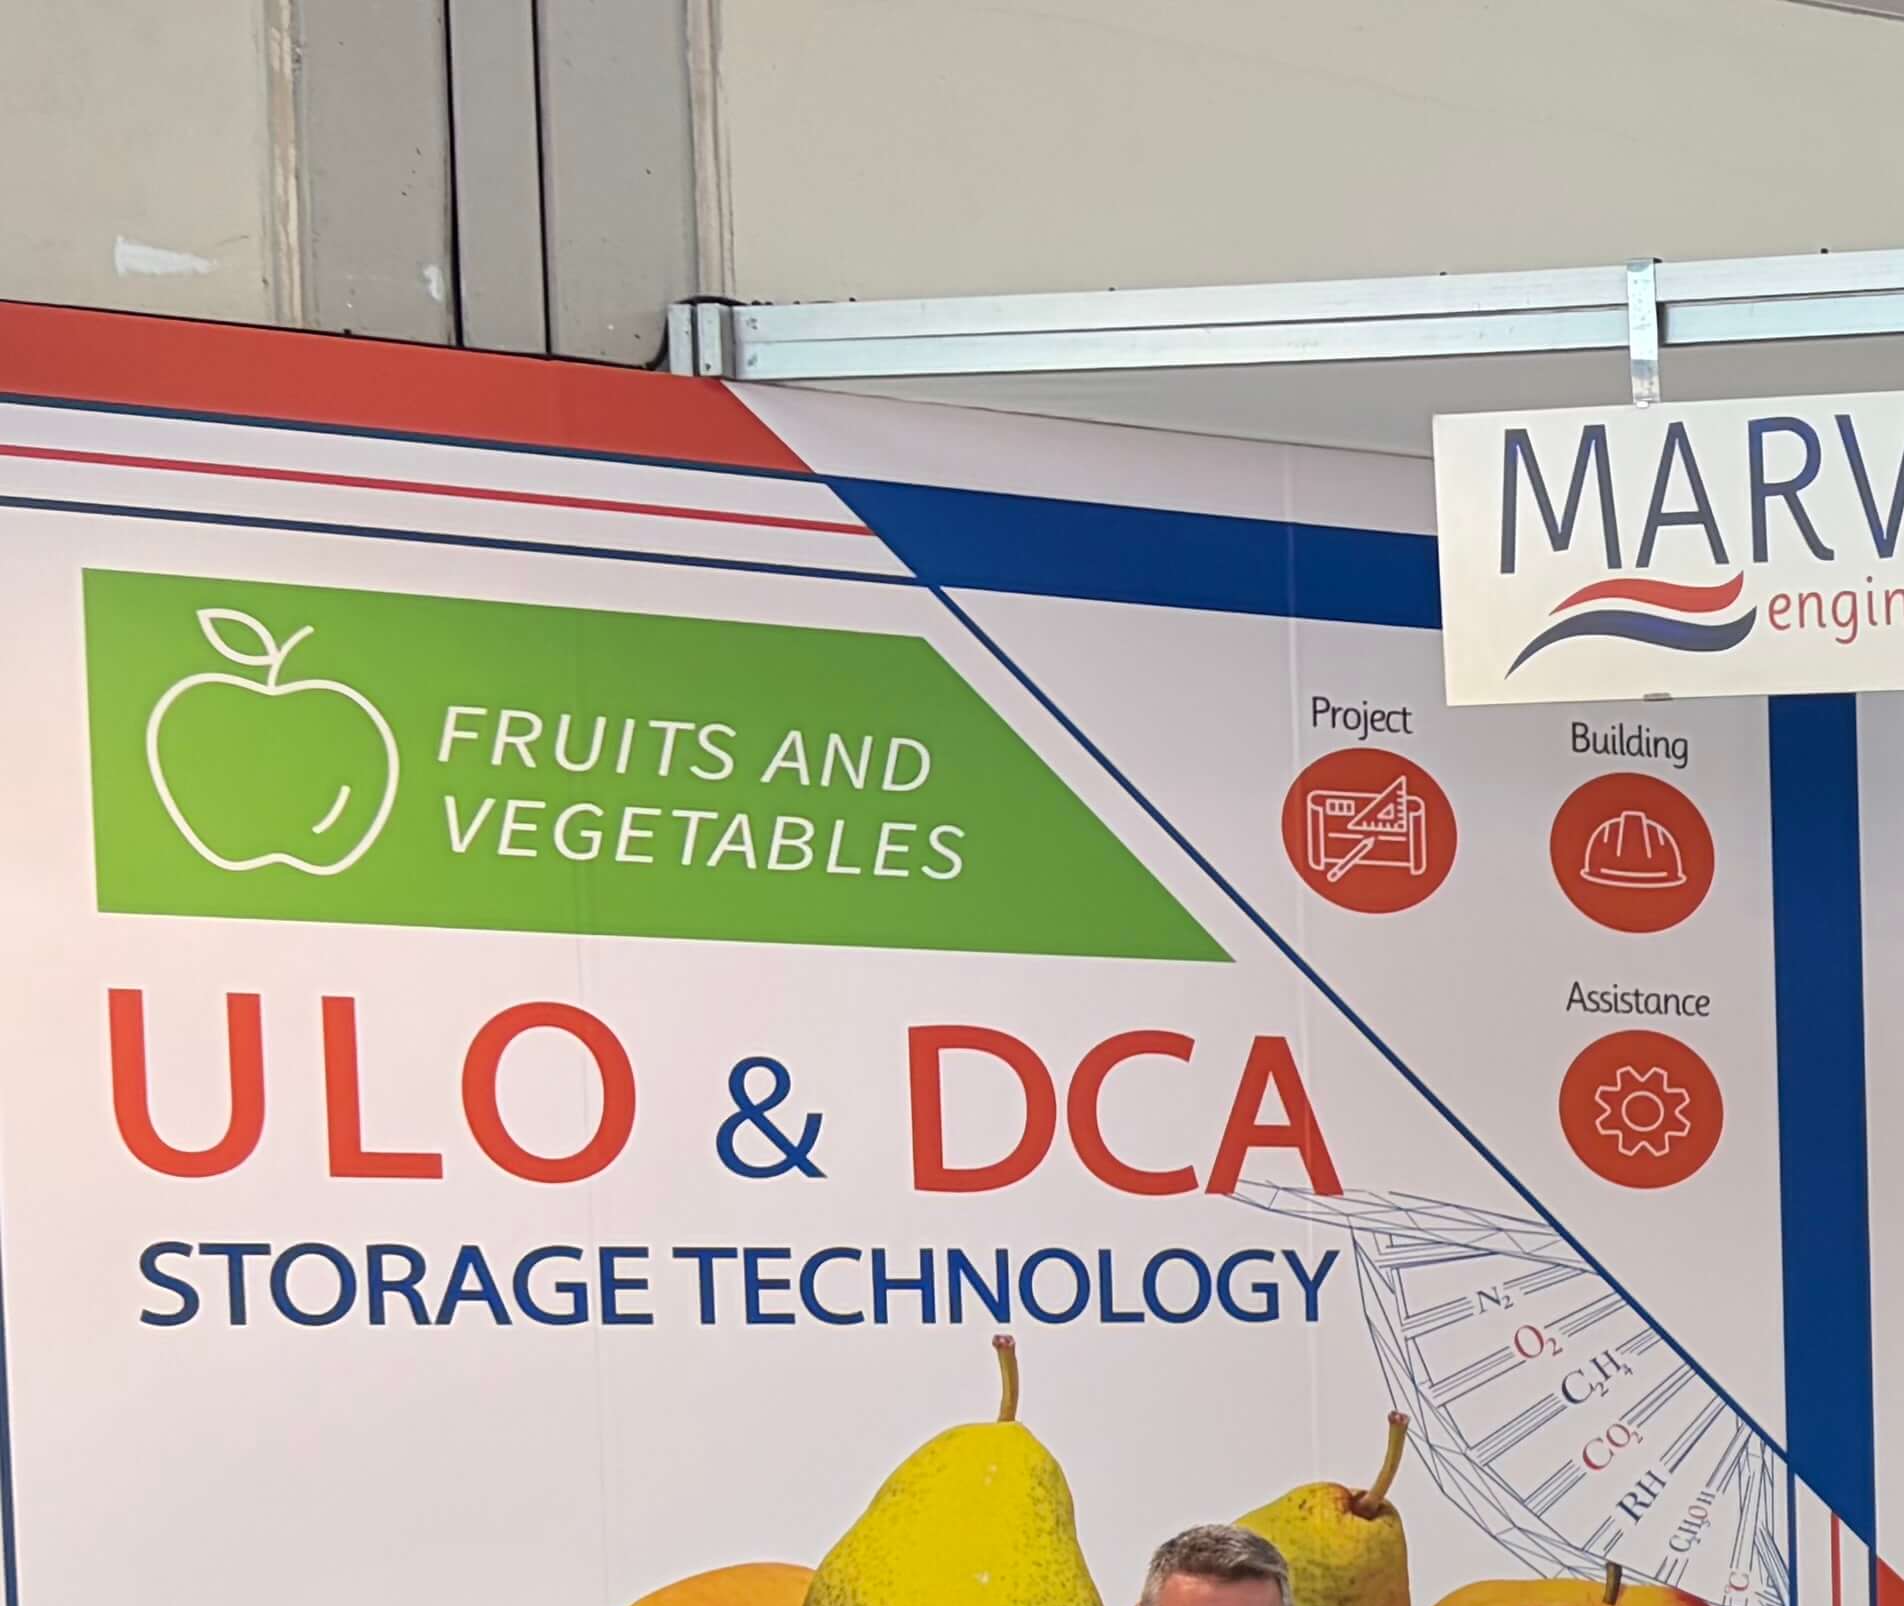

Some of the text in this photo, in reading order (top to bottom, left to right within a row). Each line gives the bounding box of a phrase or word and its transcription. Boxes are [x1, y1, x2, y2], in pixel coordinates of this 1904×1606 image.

[436, 705, 933, 794] FRUITS AND
[1309, 697, 1412, 739] Project
[1570, 722, 1690, 769] Building
[442, 795, 966, 881] VEGETABLES
[1565, 982, 1711, 1019] Assistance
[106, 988, 1345, 1197] ULO & DCA
[137, 1240, 1340, 1328] STORAGE TECHNOLOGY
[1617, 1470, 1668, 1527] RH
